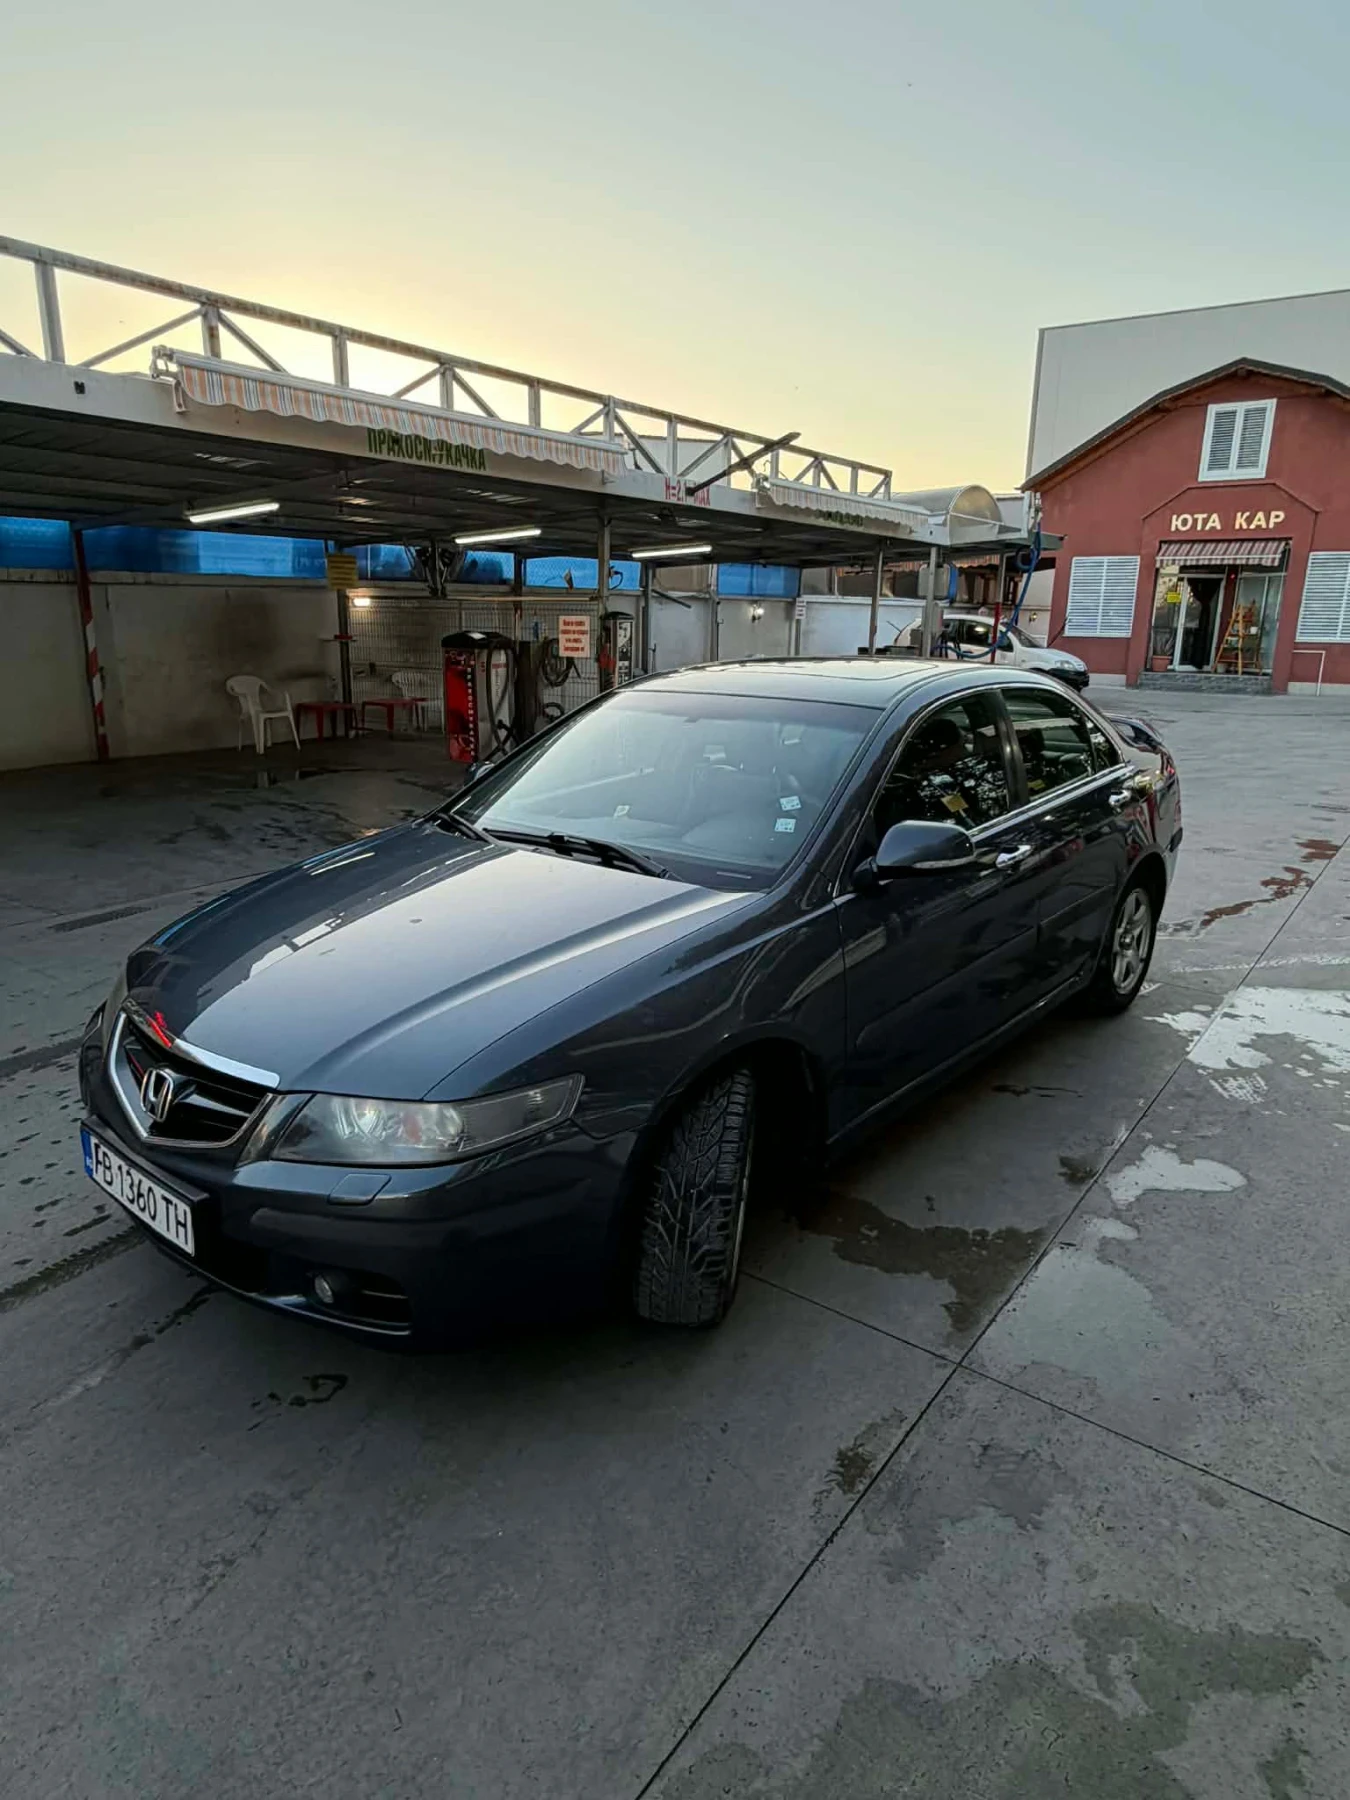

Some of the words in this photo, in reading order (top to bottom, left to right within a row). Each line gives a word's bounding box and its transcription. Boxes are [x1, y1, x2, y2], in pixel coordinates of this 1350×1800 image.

[1171, 513, 1221, 532] ЮТА
[1234, 510, 1285, 530] КАР
[117, 1164, 157, 1222] 1360
[161, 1193, 189, 1246] TH
